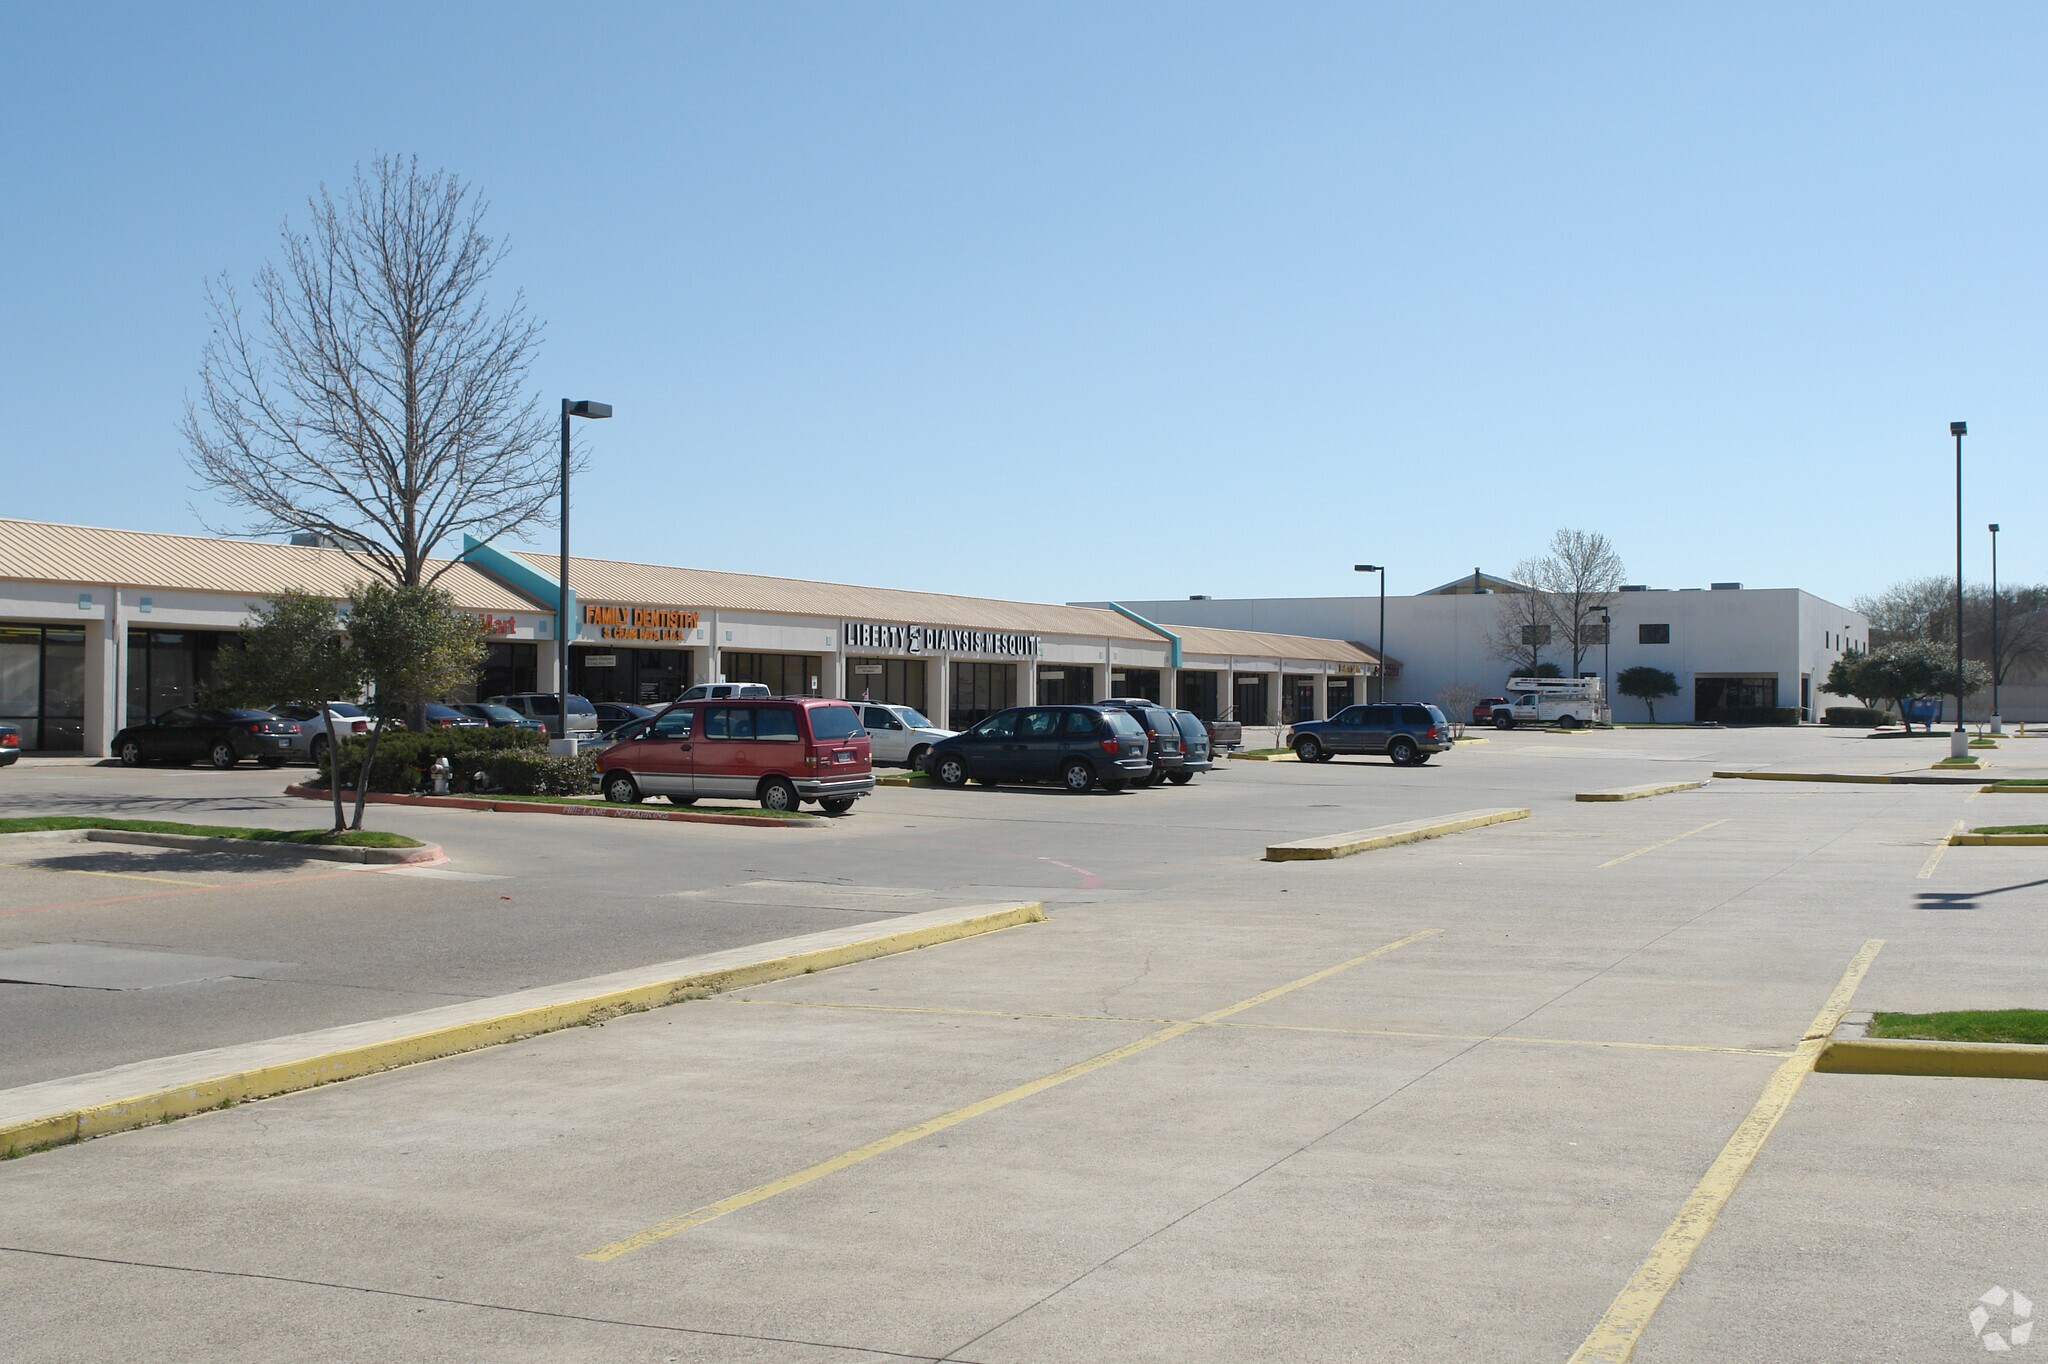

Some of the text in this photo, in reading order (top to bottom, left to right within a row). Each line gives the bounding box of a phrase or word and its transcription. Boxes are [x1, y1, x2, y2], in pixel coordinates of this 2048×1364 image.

[585, 605, 699, 629] FAMILY DENTISTRY
[846, 623, 906, 648] LIBERTY
[562, 805, 669, 820] FIRE LANE NO PARKING
